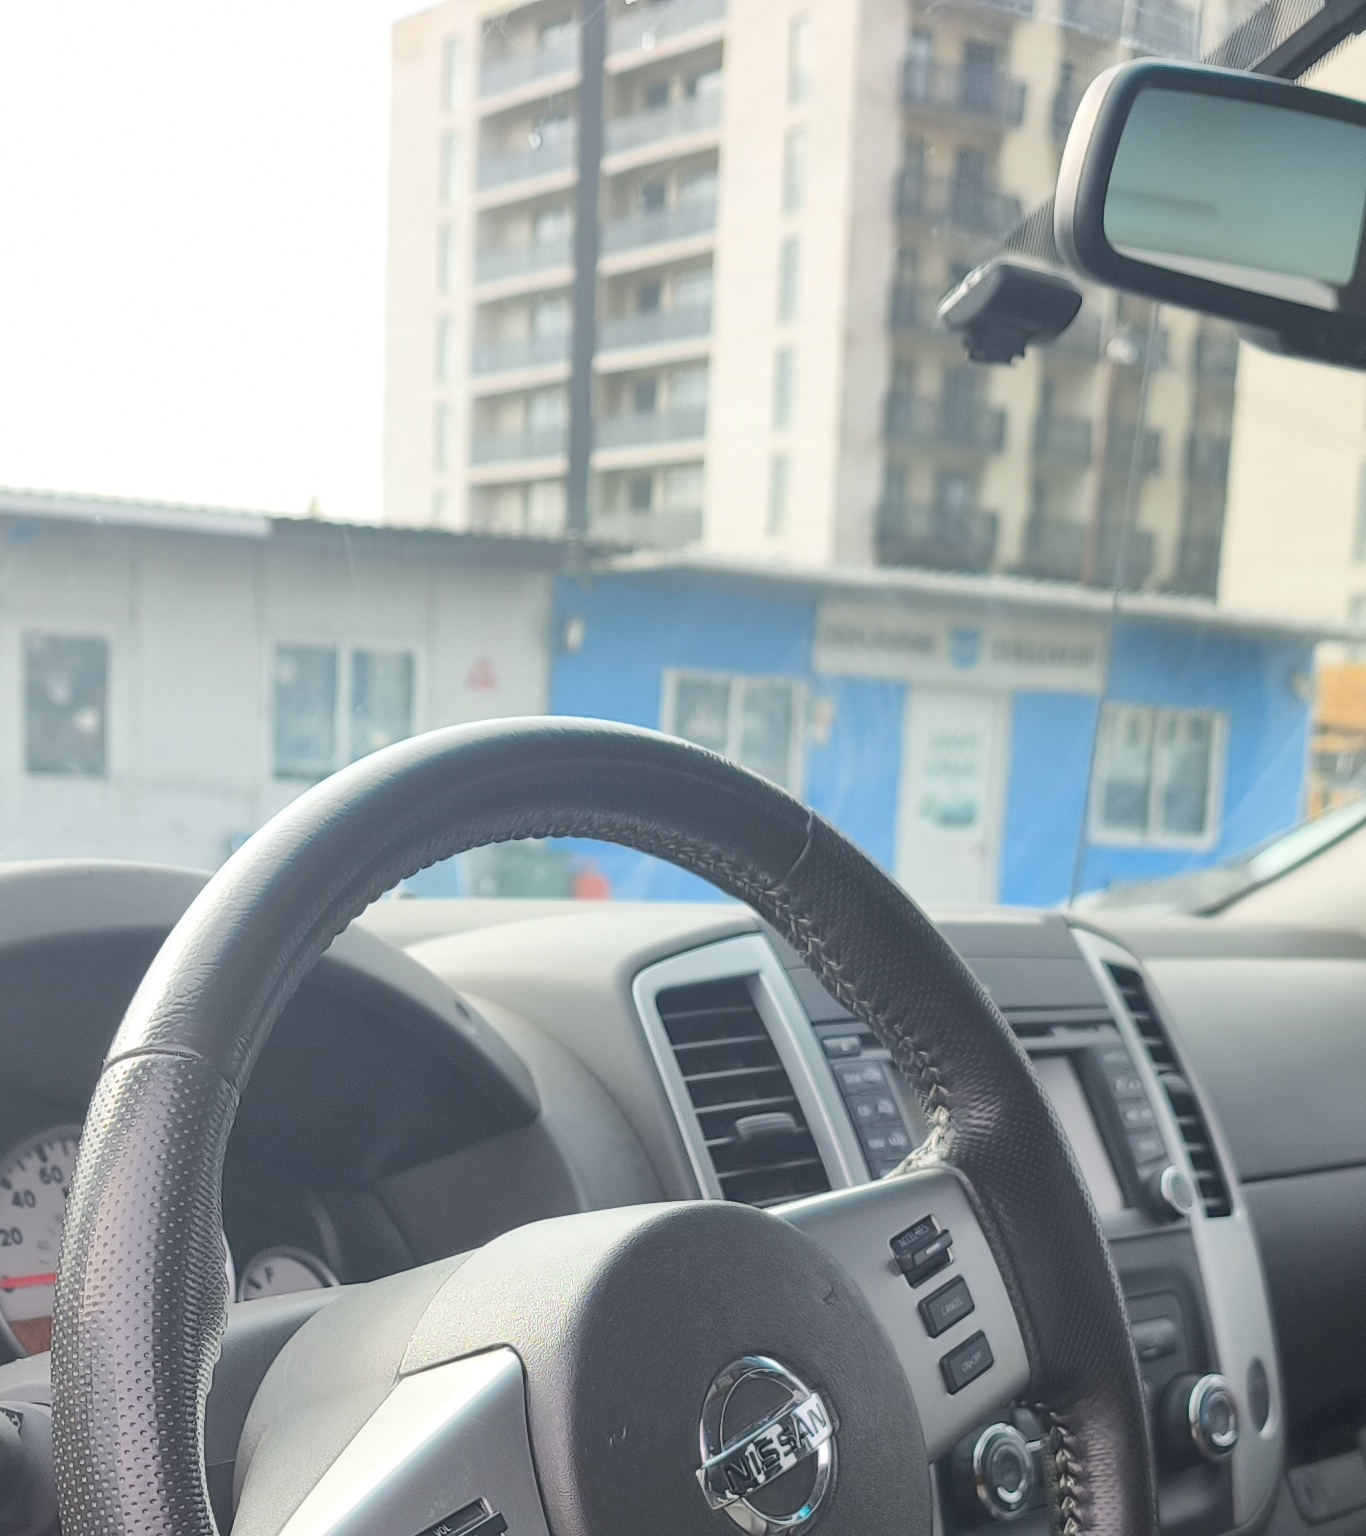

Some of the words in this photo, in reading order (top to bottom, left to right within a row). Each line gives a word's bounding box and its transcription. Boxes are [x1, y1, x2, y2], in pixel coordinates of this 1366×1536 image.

[39, 1165, 64, 1184] 60
[12, 1190, 36, 1208] 40
[723, 1403, 827, 1492] NISSAN
